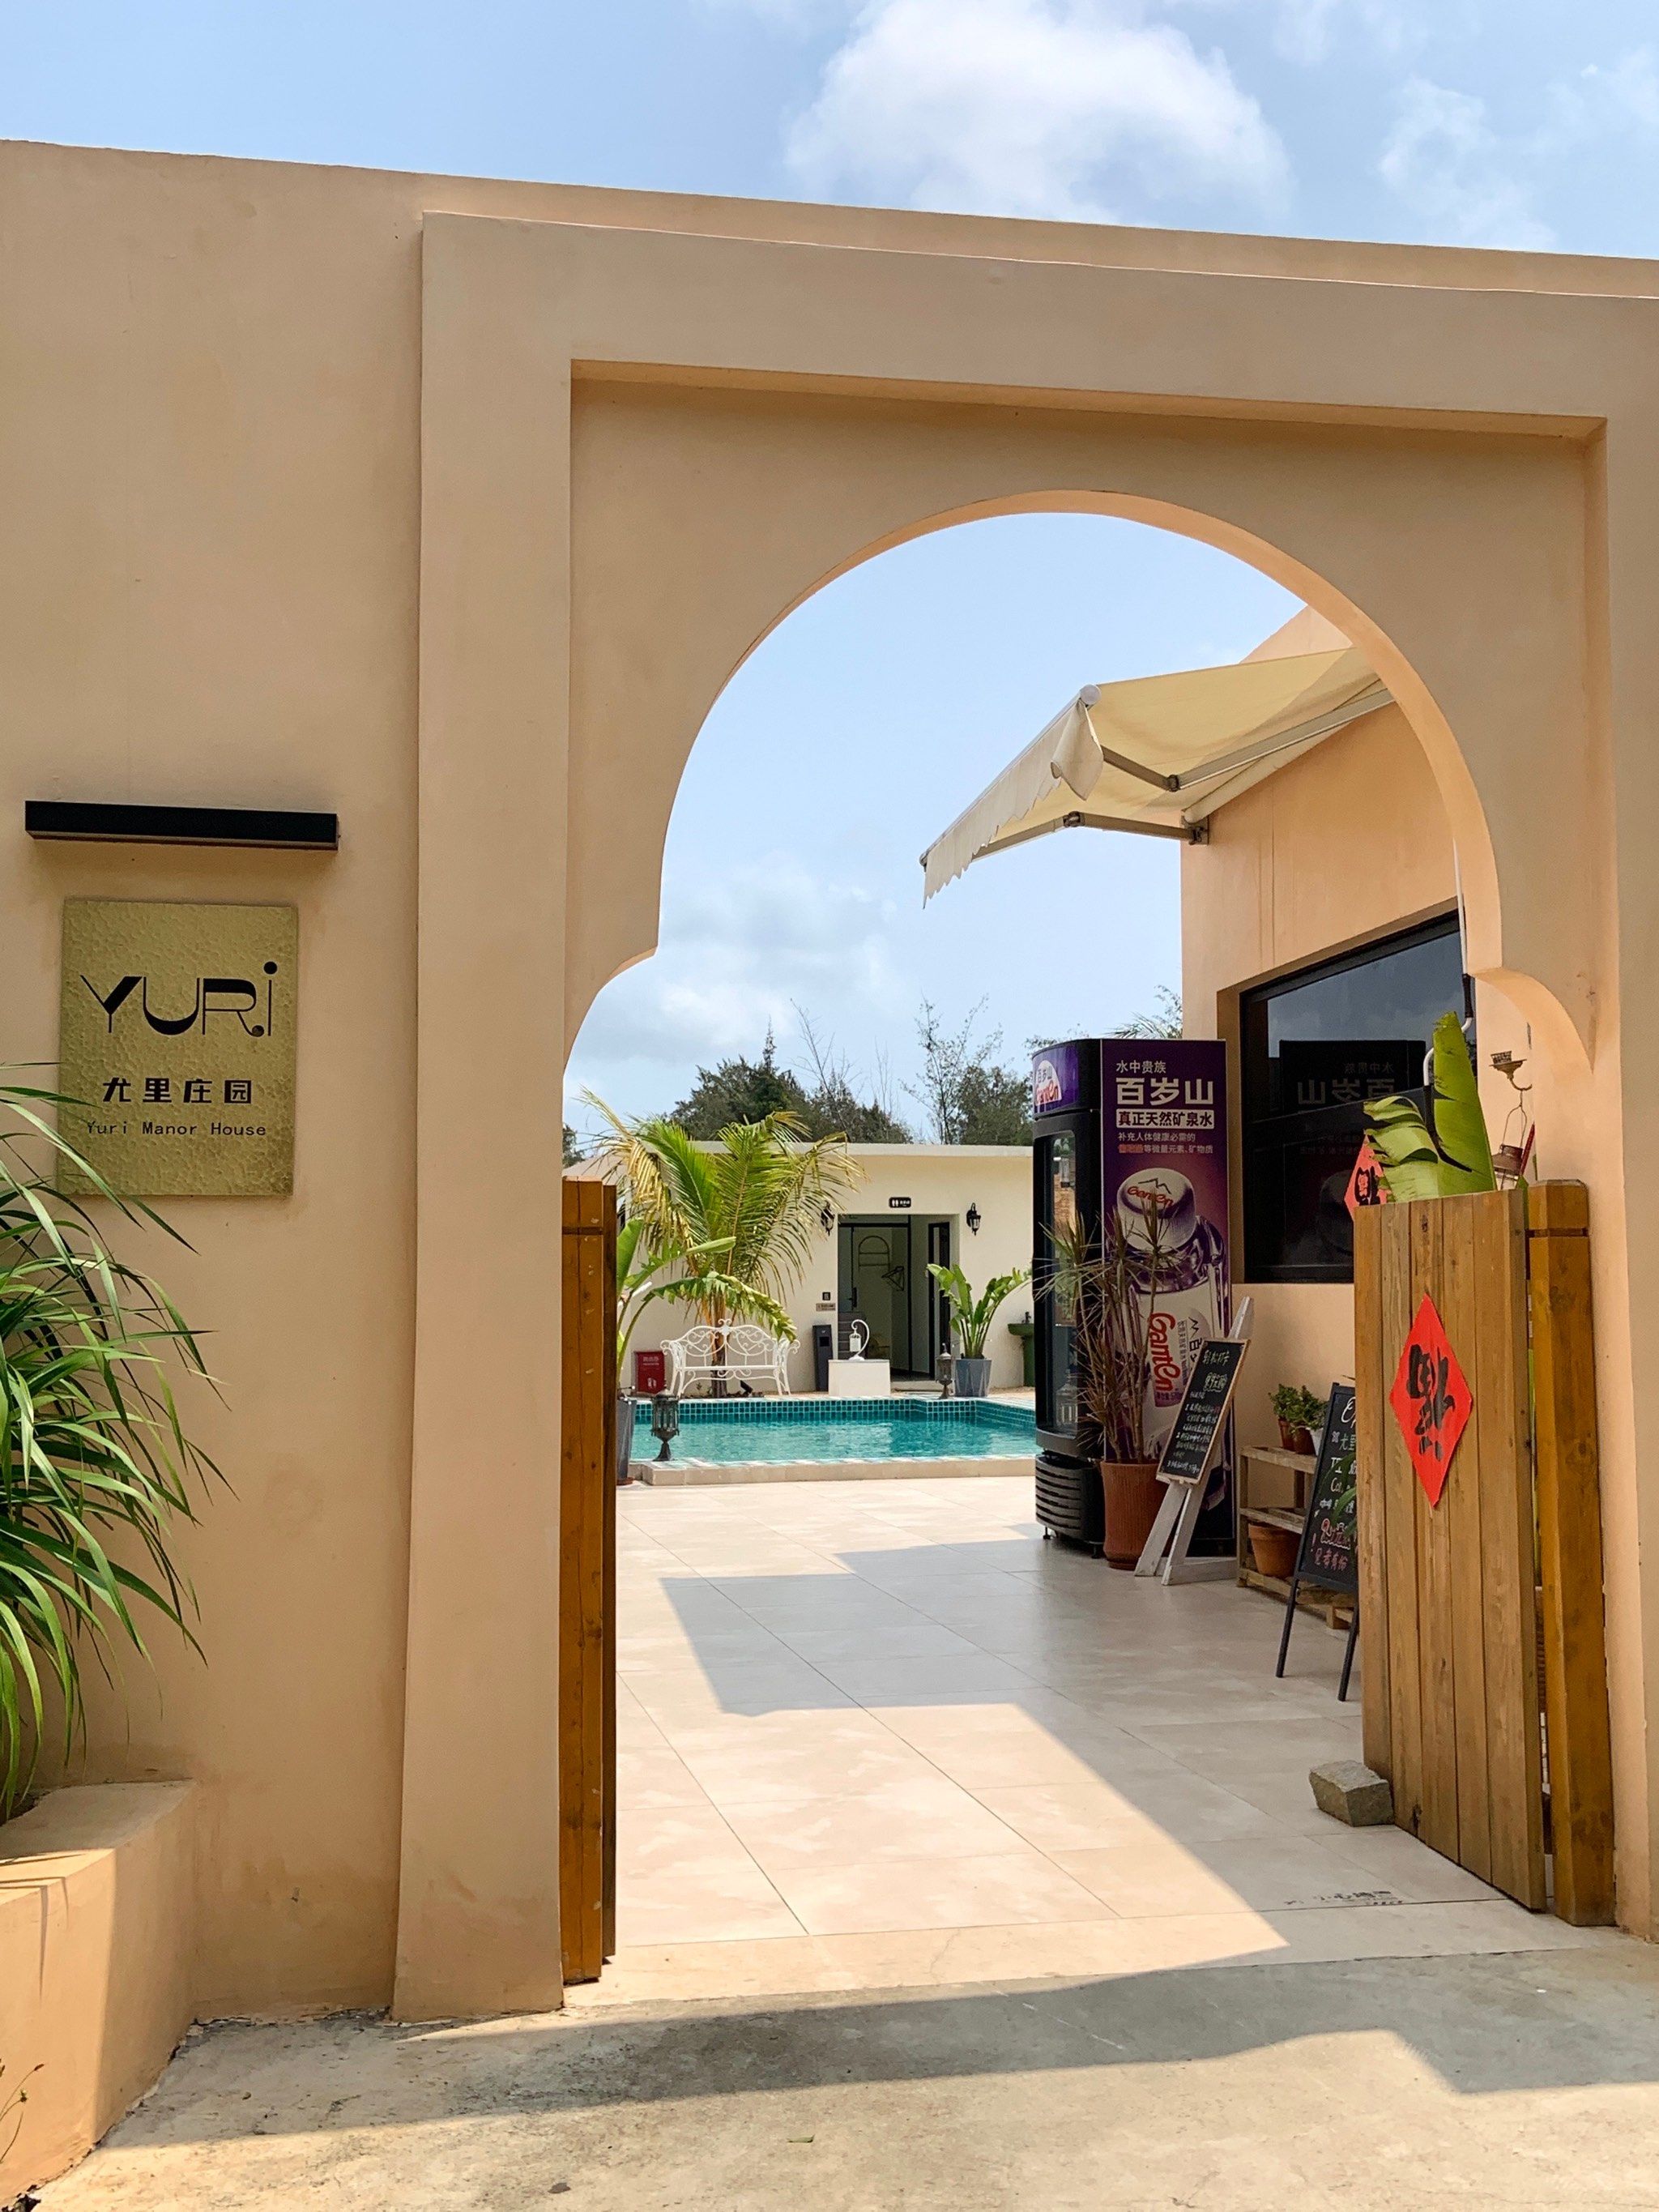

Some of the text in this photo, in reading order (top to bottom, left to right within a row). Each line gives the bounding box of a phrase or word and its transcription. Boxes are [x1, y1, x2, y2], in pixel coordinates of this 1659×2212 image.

[1115, 1060, 1166, 1074] 水中贵族
[102, 1078, 253, 1104] 尤里庄园
[1115, 1077, 1213, 1106] 百岁山
[1119, 1111, 1213, 1127] 真正天然矿泉水
[87, 1121, 267, 1137] Yuri Manor House
